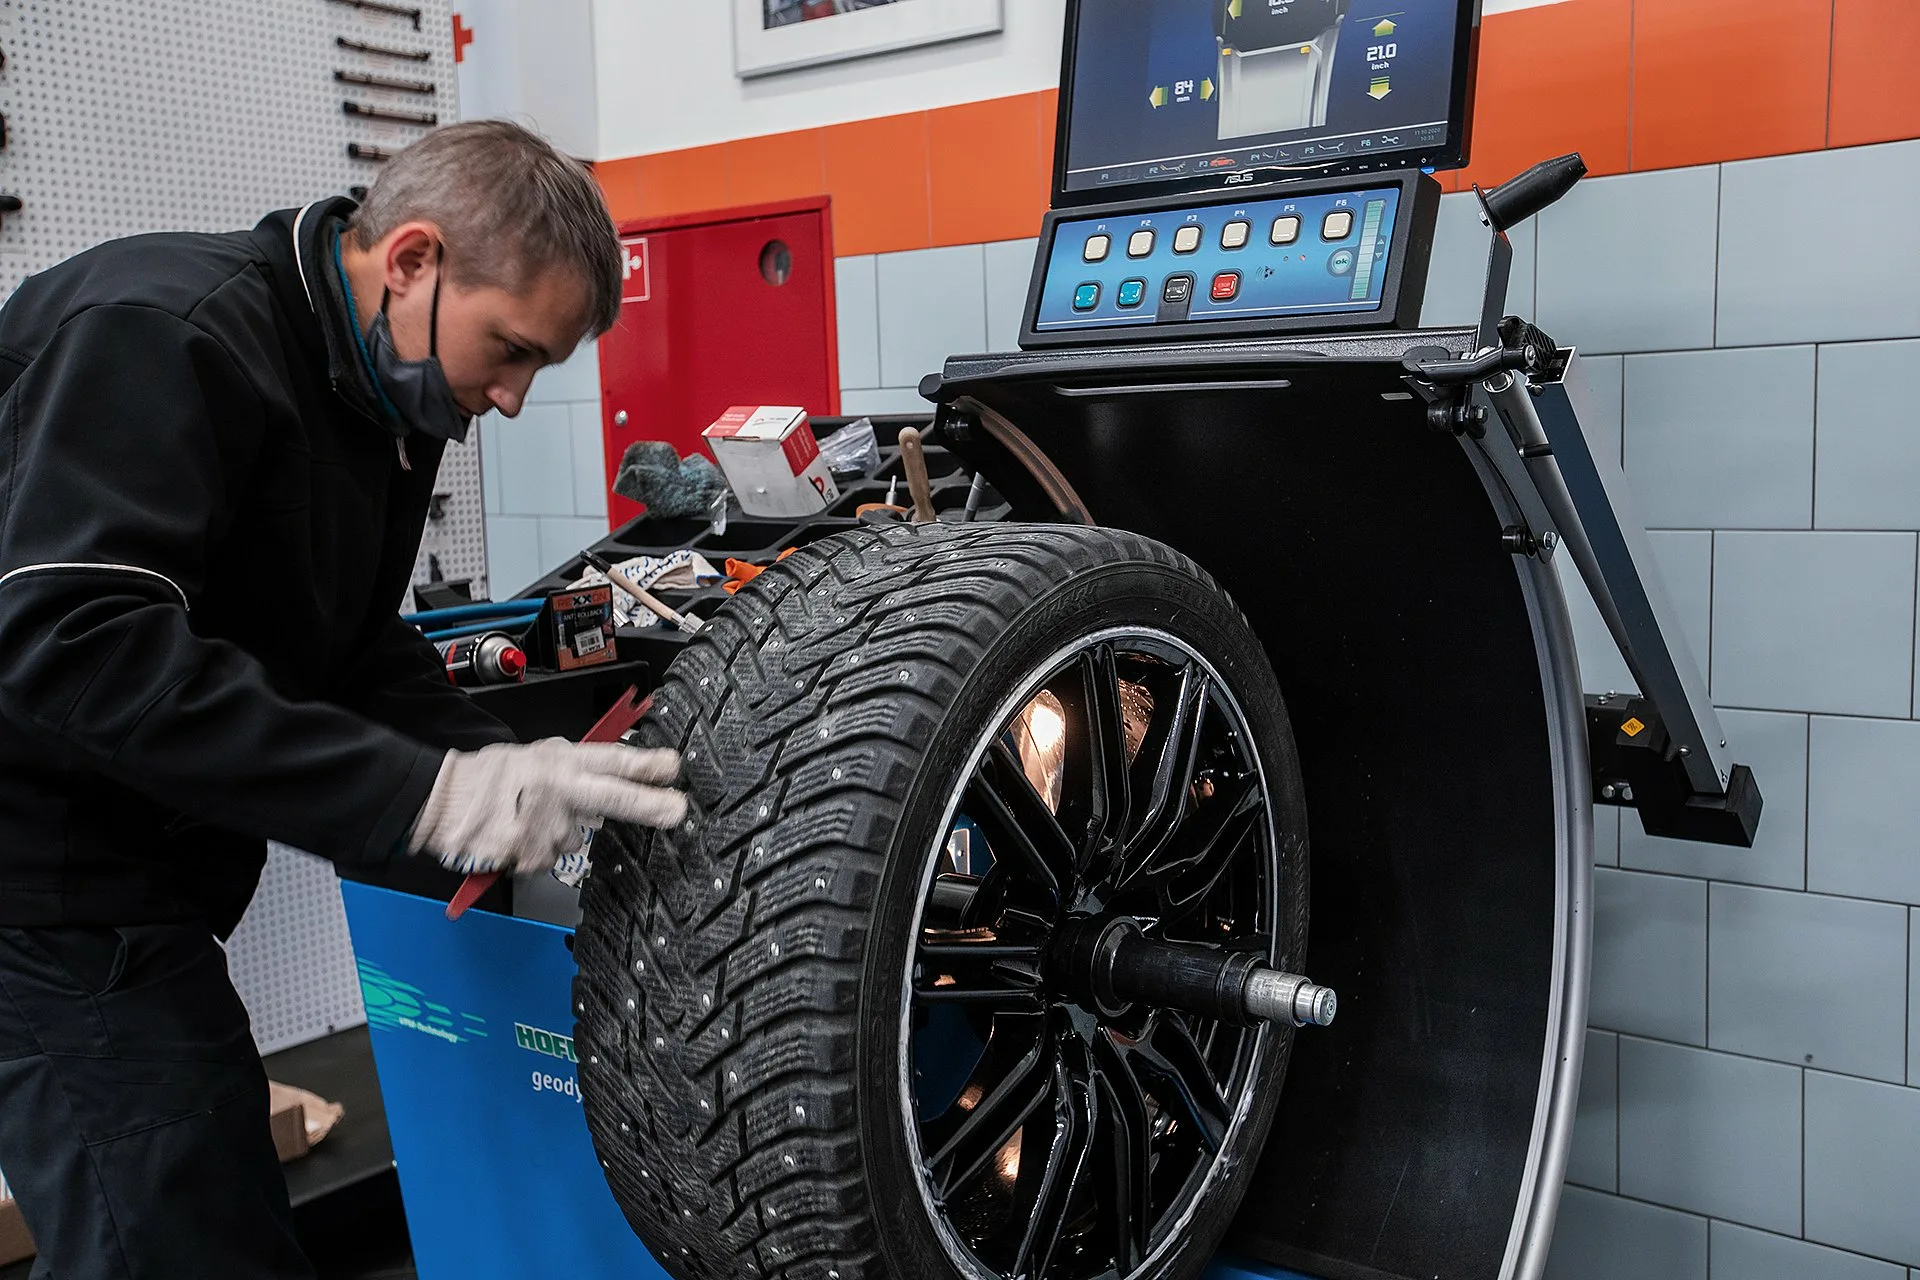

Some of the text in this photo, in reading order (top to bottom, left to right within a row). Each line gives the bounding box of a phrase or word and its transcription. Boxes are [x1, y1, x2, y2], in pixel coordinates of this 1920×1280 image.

[1271, 7, 1289, 15] inch
[1366, 43, 1397, 61] 21.0
[1371, 61, 1390, 70] inch
[1174, 80, 1194, 95] 84
[1224, 173, 1254, 185] ASUS
[1141, 219, 1152, 227] F2
[1186, 214, 1198, 222] F3
[1234, 209, 1246, 217] F4
[1284, 204, 1296, 212] F5
[1335, 199, 1347, 207] F6
